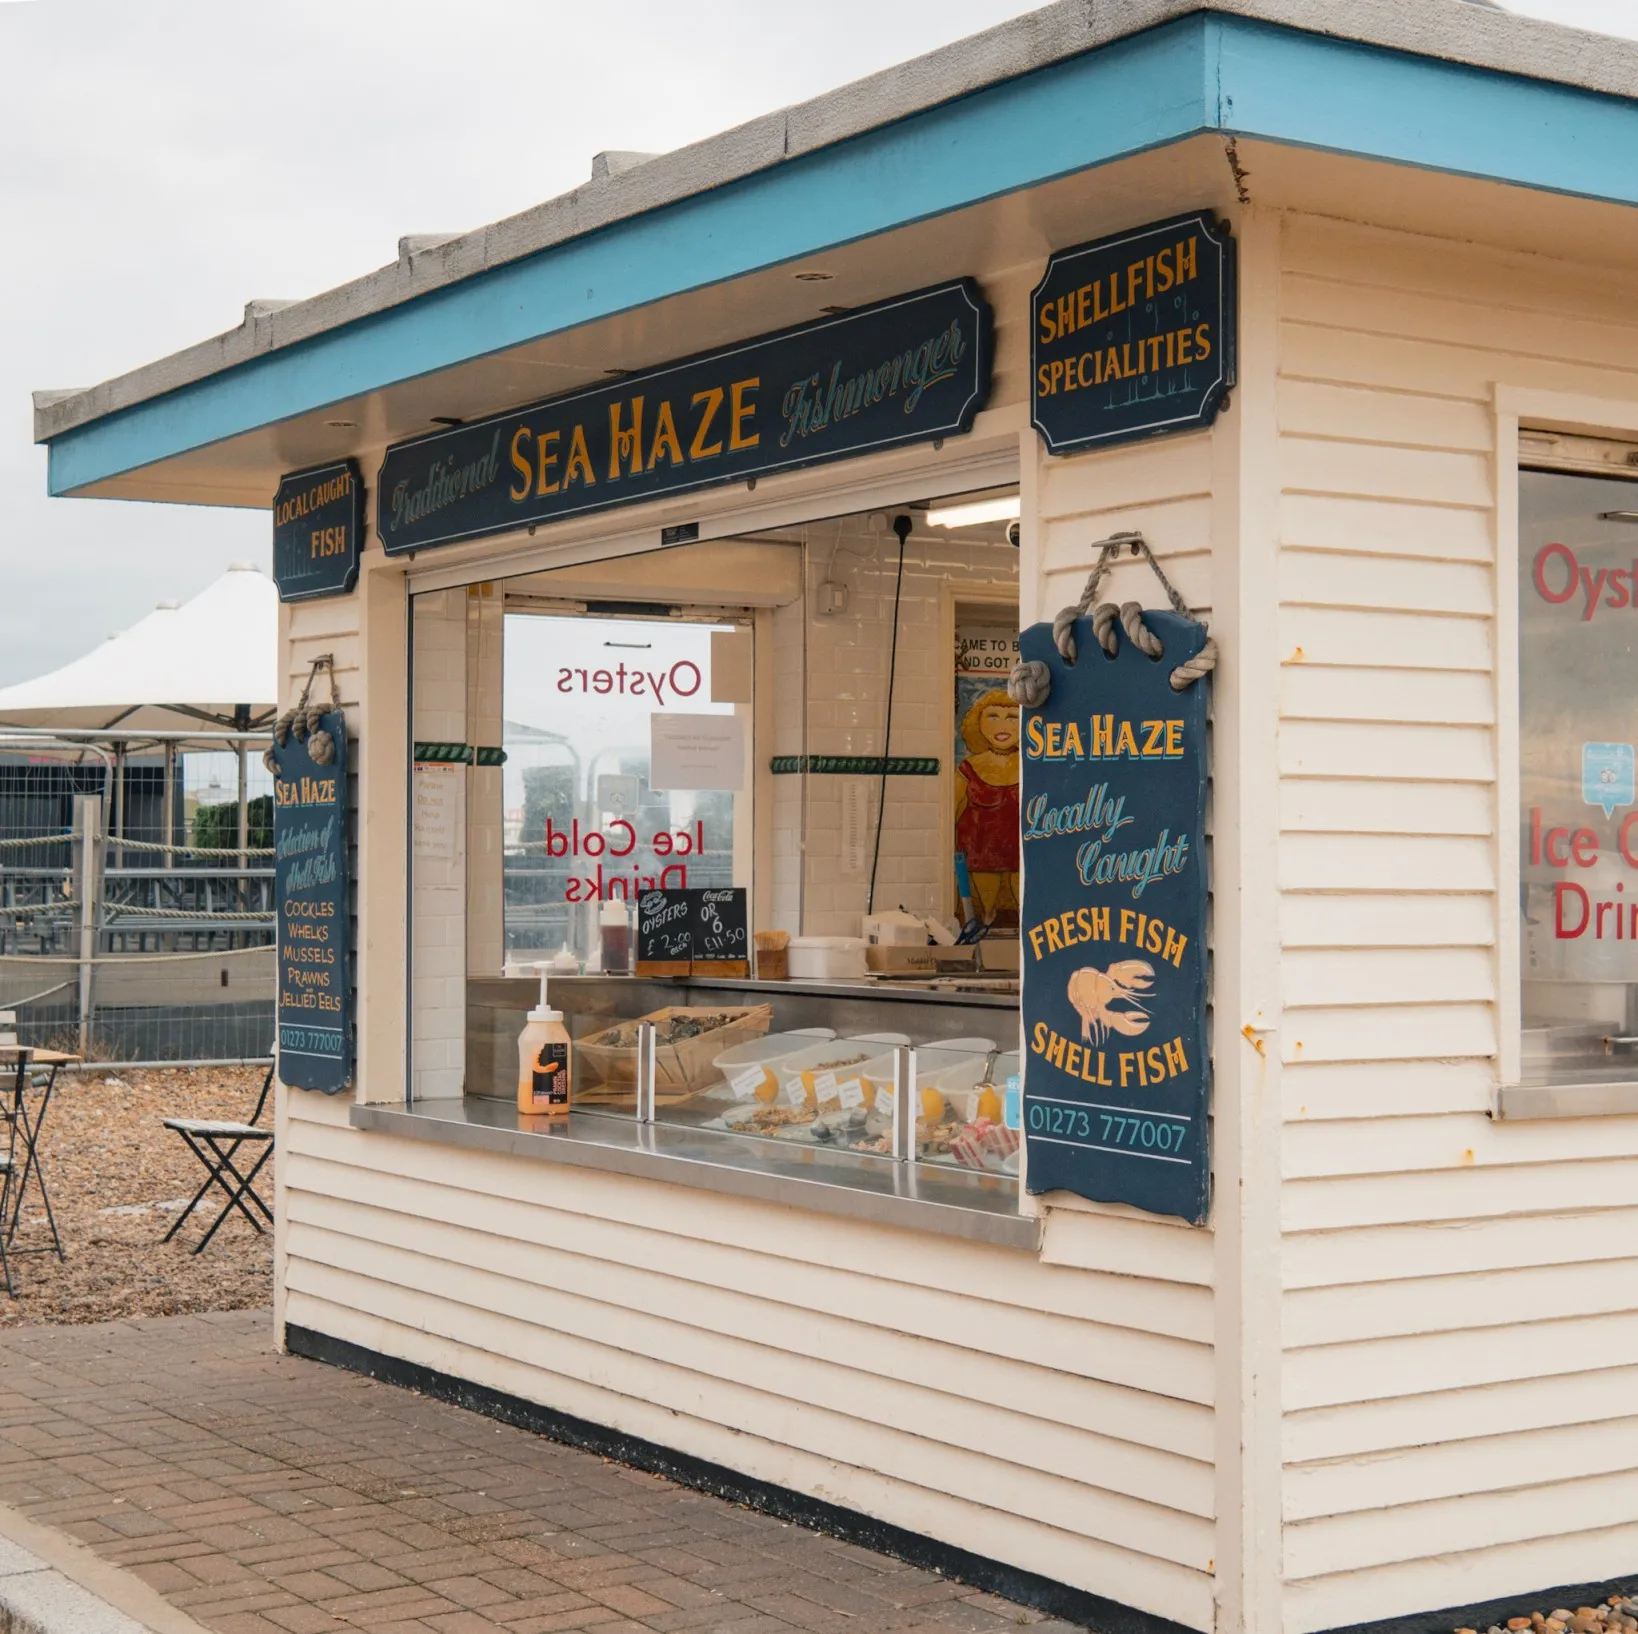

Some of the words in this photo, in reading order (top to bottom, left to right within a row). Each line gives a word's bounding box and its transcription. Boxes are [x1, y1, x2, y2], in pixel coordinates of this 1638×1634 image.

[1040, 236, 1198, 344] SHELLFISH
[1038, 323, 1211, 397] SPECIALITIES
[390, 428, 501, 532] Traditional
[509, 425, 597, 504] SEA
[607, 376, 760, 483] HAZE
[779, 318, 967, 447] Fishmonger
[276, 493, 309, 526] LOCAL
[310, 472, 352, 510] CAUGHT
[311, 525, 347, 559] FISH
[991, 640, 1007, 652] TO
[984, 657, 1010, 669] GOT
[1026, 715, 1085, 762] SEA
[1089, 714, 1185, 761] HAZE
[275, 779, 299, 808] SEA
[301, 776, 336, 807] HAZE
[1024, 782, 1135, 843] Locally
[1532, 806, 1599, 868] Ice
[1076, 829, 1189, 899] Caught
[284, 900, 335, 919] COCKLES
[642, 901, 688, 934] OYSTERS
[701, 902, 718, 922] OR
[712, 916, 723, 933] 6
[288, 923, 329, 943] WHELKS
[1028, 906, 1111, 962] FRESH
[1119, 908, 1188, 969] FISH
[283, 945, 335, 964] MUSSELS
[287, 967, 330, 987] PRAWNS
[279, 989, 317, 1009] JELLIED
[318, 992, 341, 1011] EELS
[280, 1029, 305, 1048] 01273
[308, 1032, 342, 1051] 777007
[1031, 1022, 1113, 1087] SHELL
[1119, 1036, 1190, 1088] FISH
[1030, 1104, 1091, 1137] 01273
[1100, 1114, 1186, 1153] 777007
